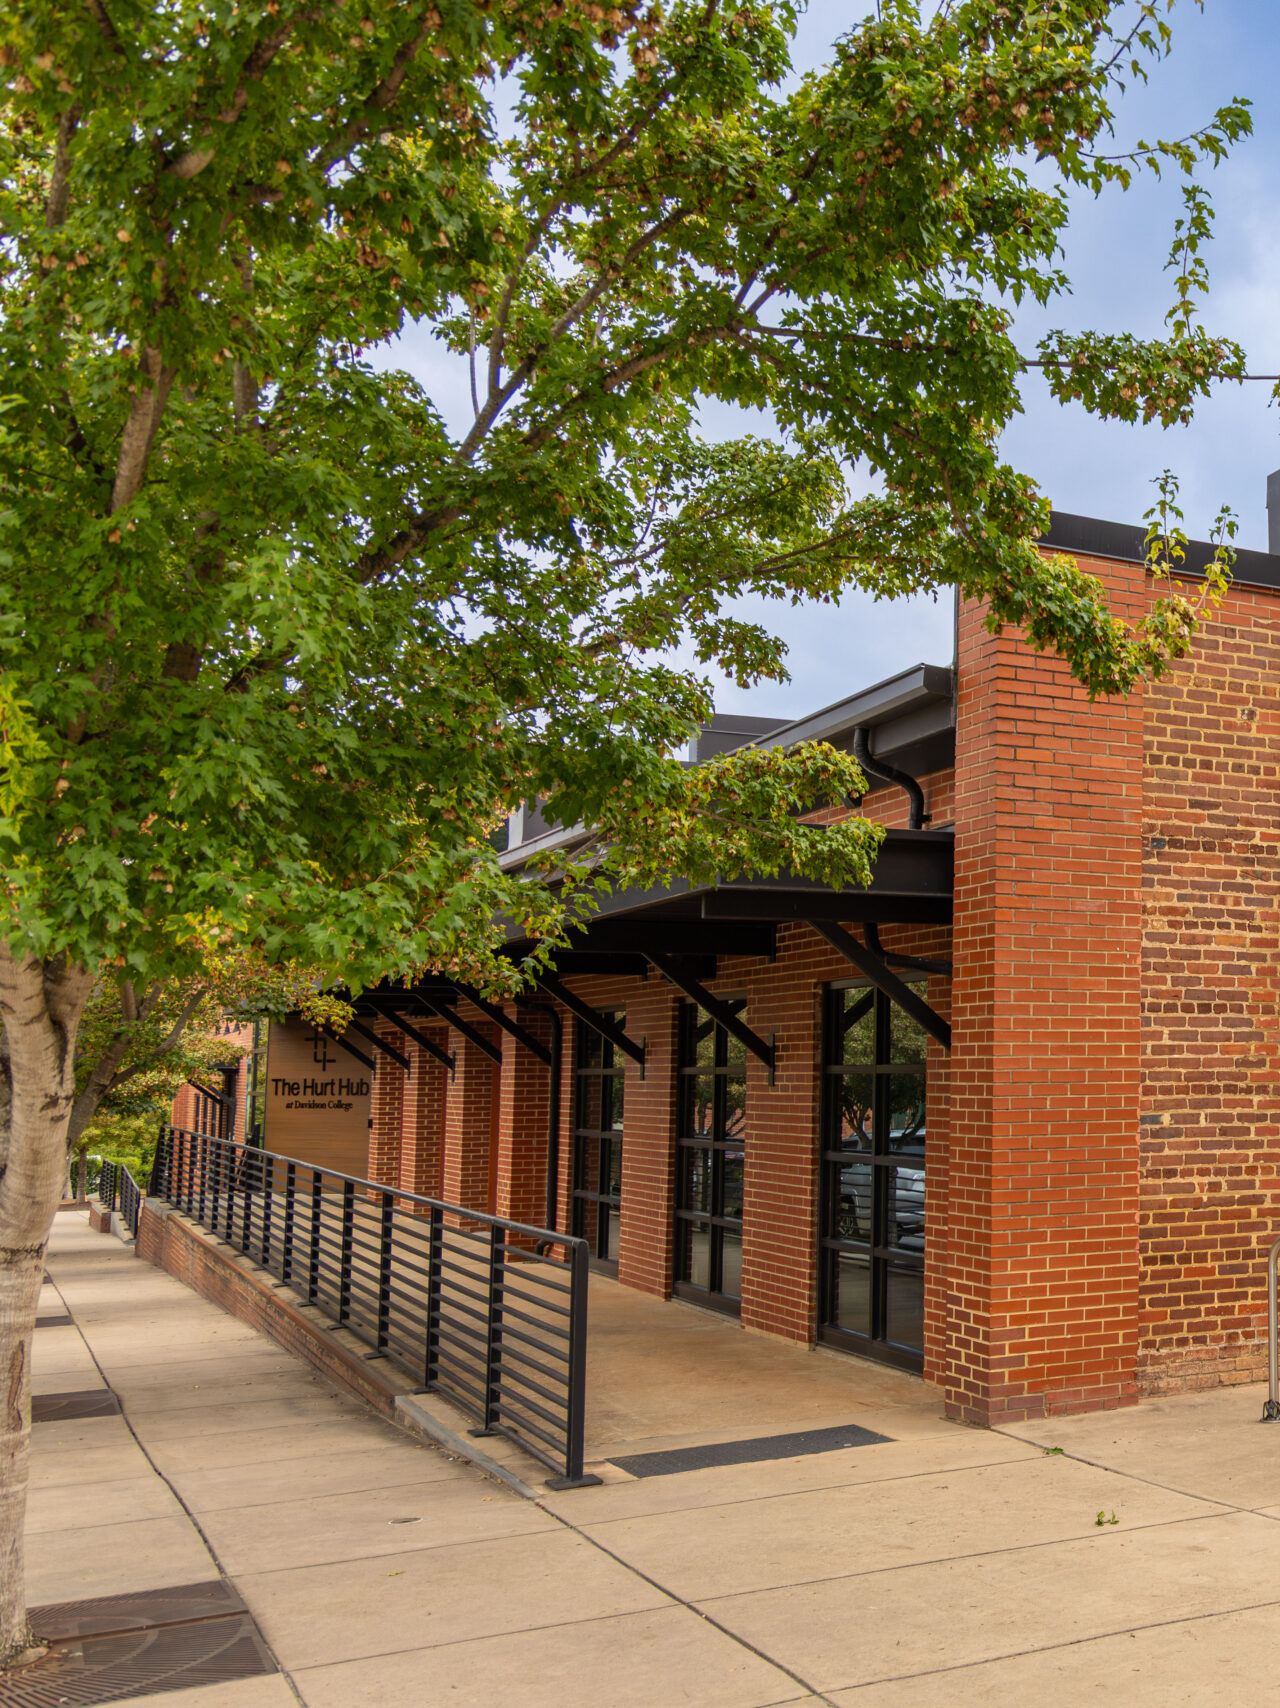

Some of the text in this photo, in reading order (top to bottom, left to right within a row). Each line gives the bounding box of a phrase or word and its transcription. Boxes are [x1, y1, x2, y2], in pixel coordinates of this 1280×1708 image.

[272, 1078, 370, 1096] The Hurt Hub
[286, 1100, 353, 1112] at Davidson College
